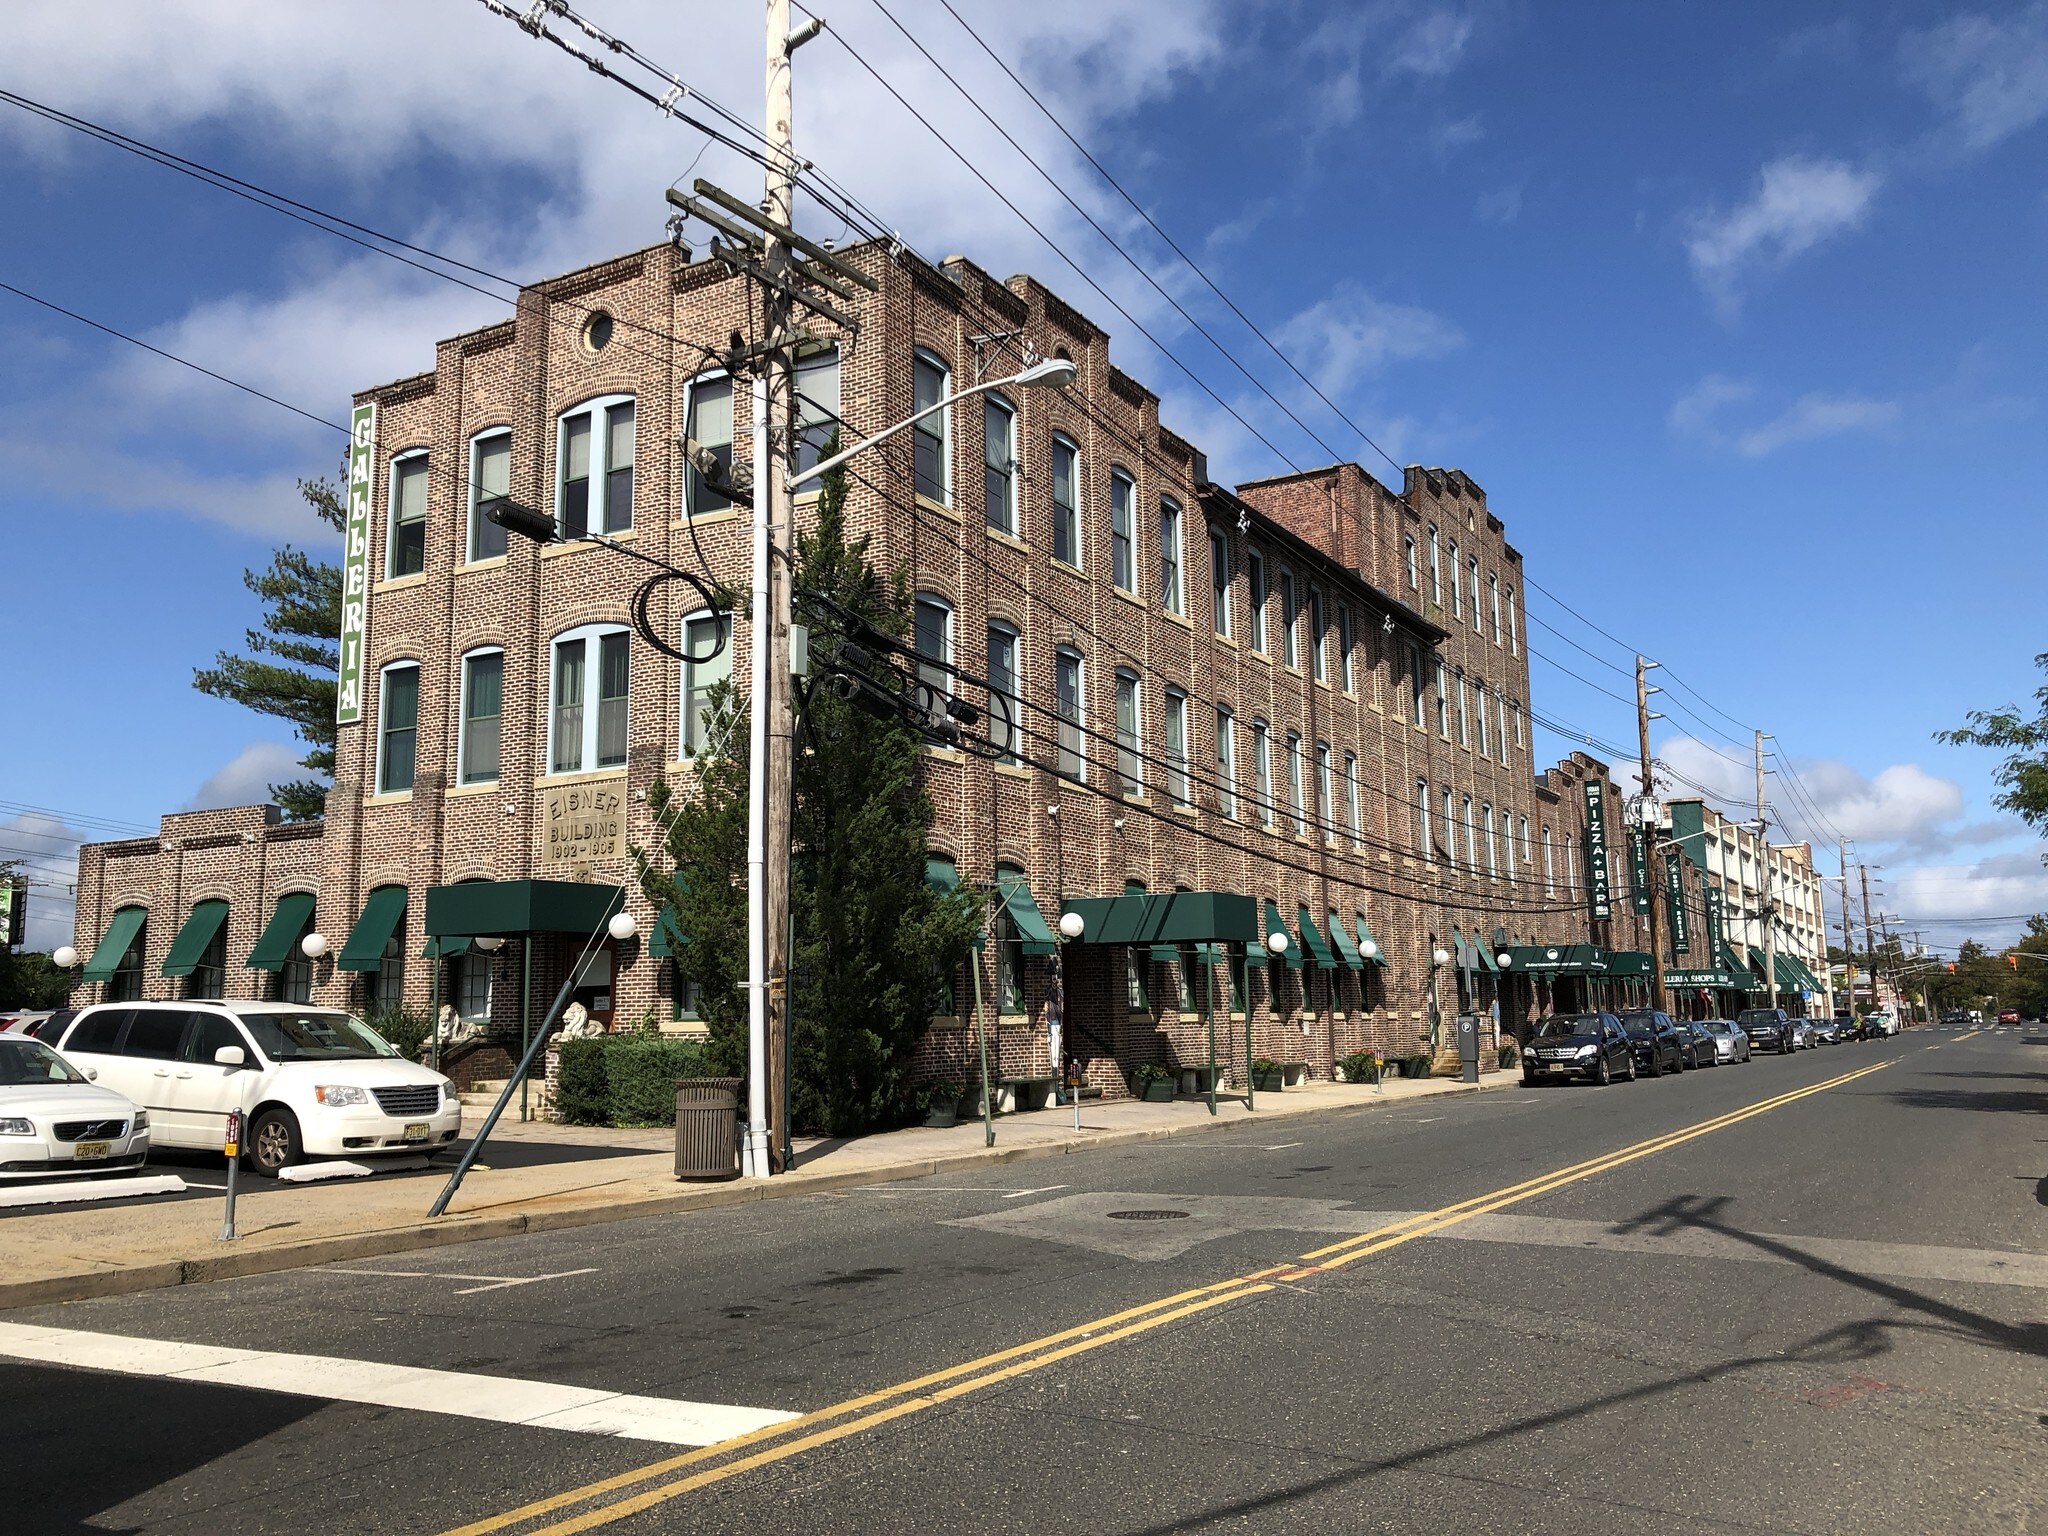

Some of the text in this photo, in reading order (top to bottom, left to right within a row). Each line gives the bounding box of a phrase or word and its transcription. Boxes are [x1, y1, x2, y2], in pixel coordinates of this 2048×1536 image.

[341, 418, 371, 710] GALLERIA
[550, 790, 620, 820] EISNER
[550, 821, 617, 842] BUILDING
[551, 843, 577, 859] 1902
[1710, 905, 1720, 952] Melting
[1664, 975, 1689, 983] LLERIA
[1691, 974, 1715, 983] SHOPS
